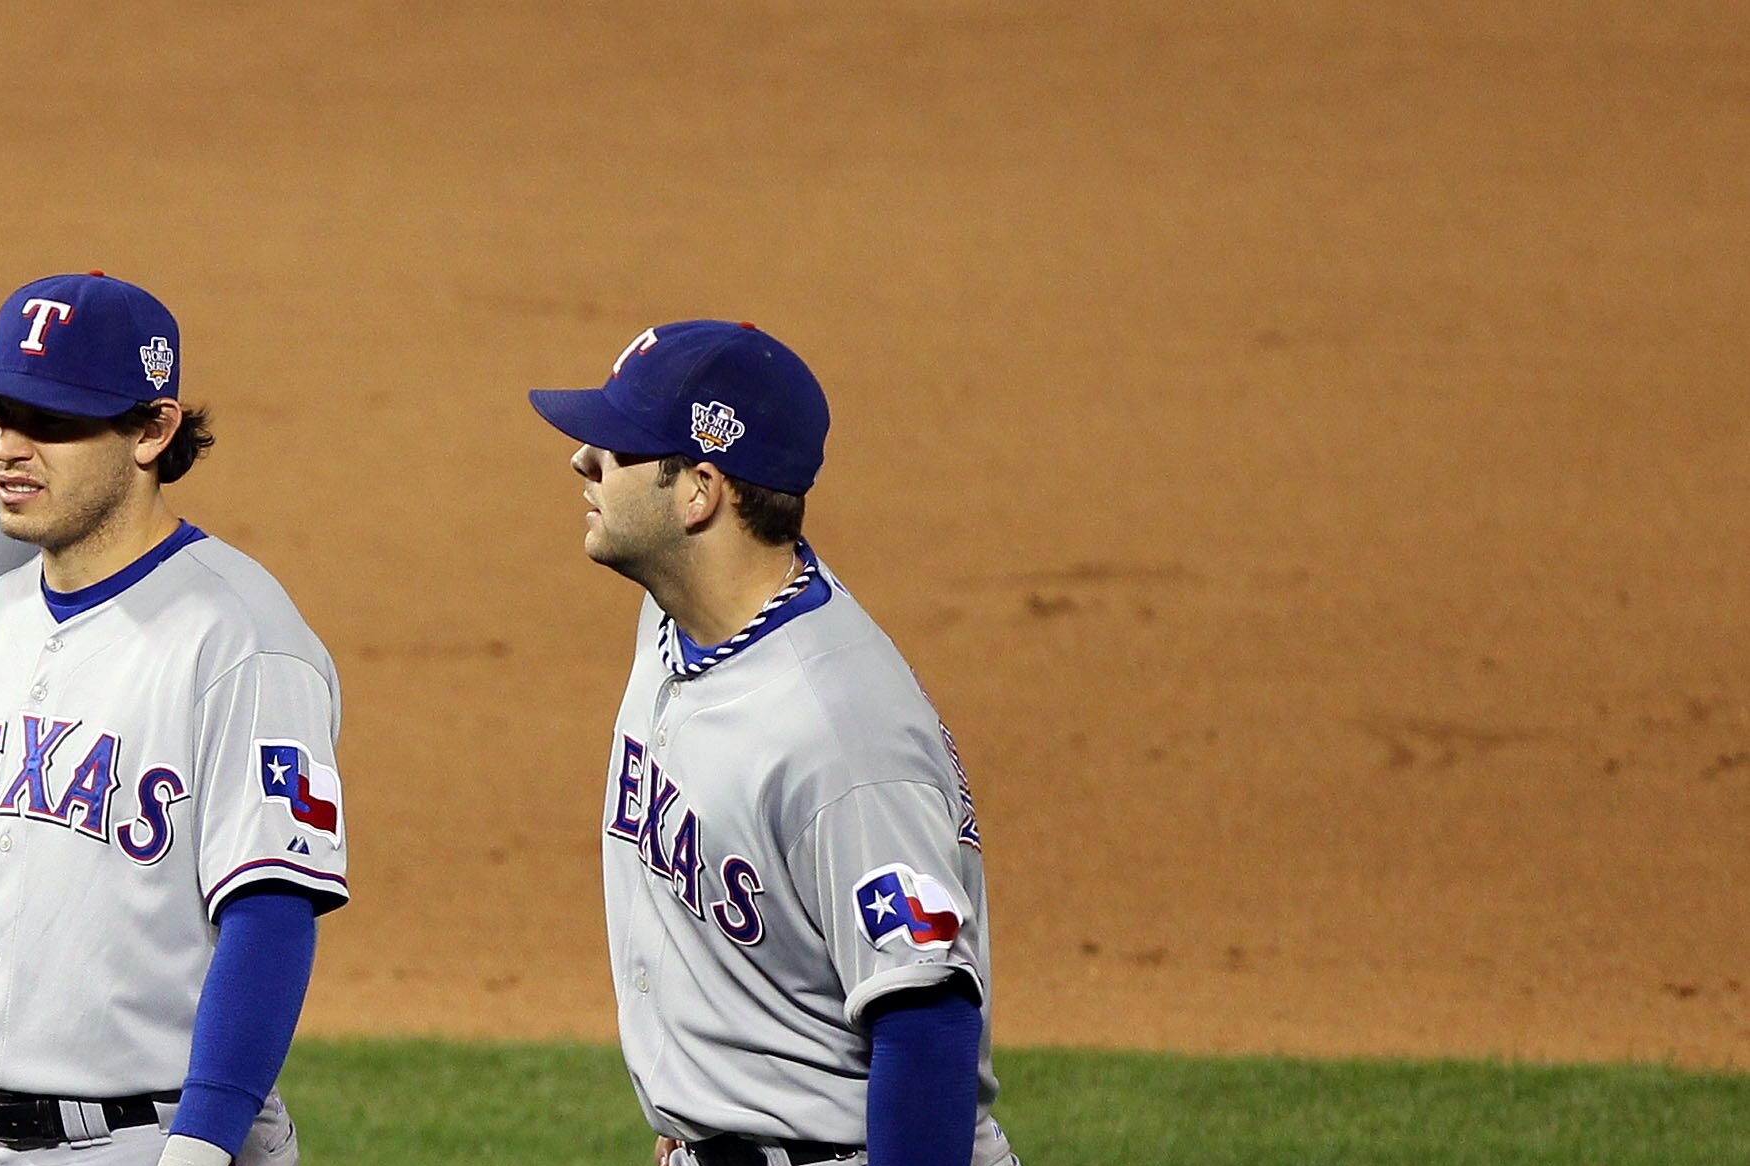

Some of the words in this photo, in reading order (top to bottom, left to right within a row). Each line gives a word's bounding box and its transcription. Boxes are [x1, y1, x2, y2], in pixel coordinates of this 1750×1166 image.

[20, 298, 74, 356] T
[694, 405, 743, 435] WORLD
[694, 419, 732, 443] SERIES
